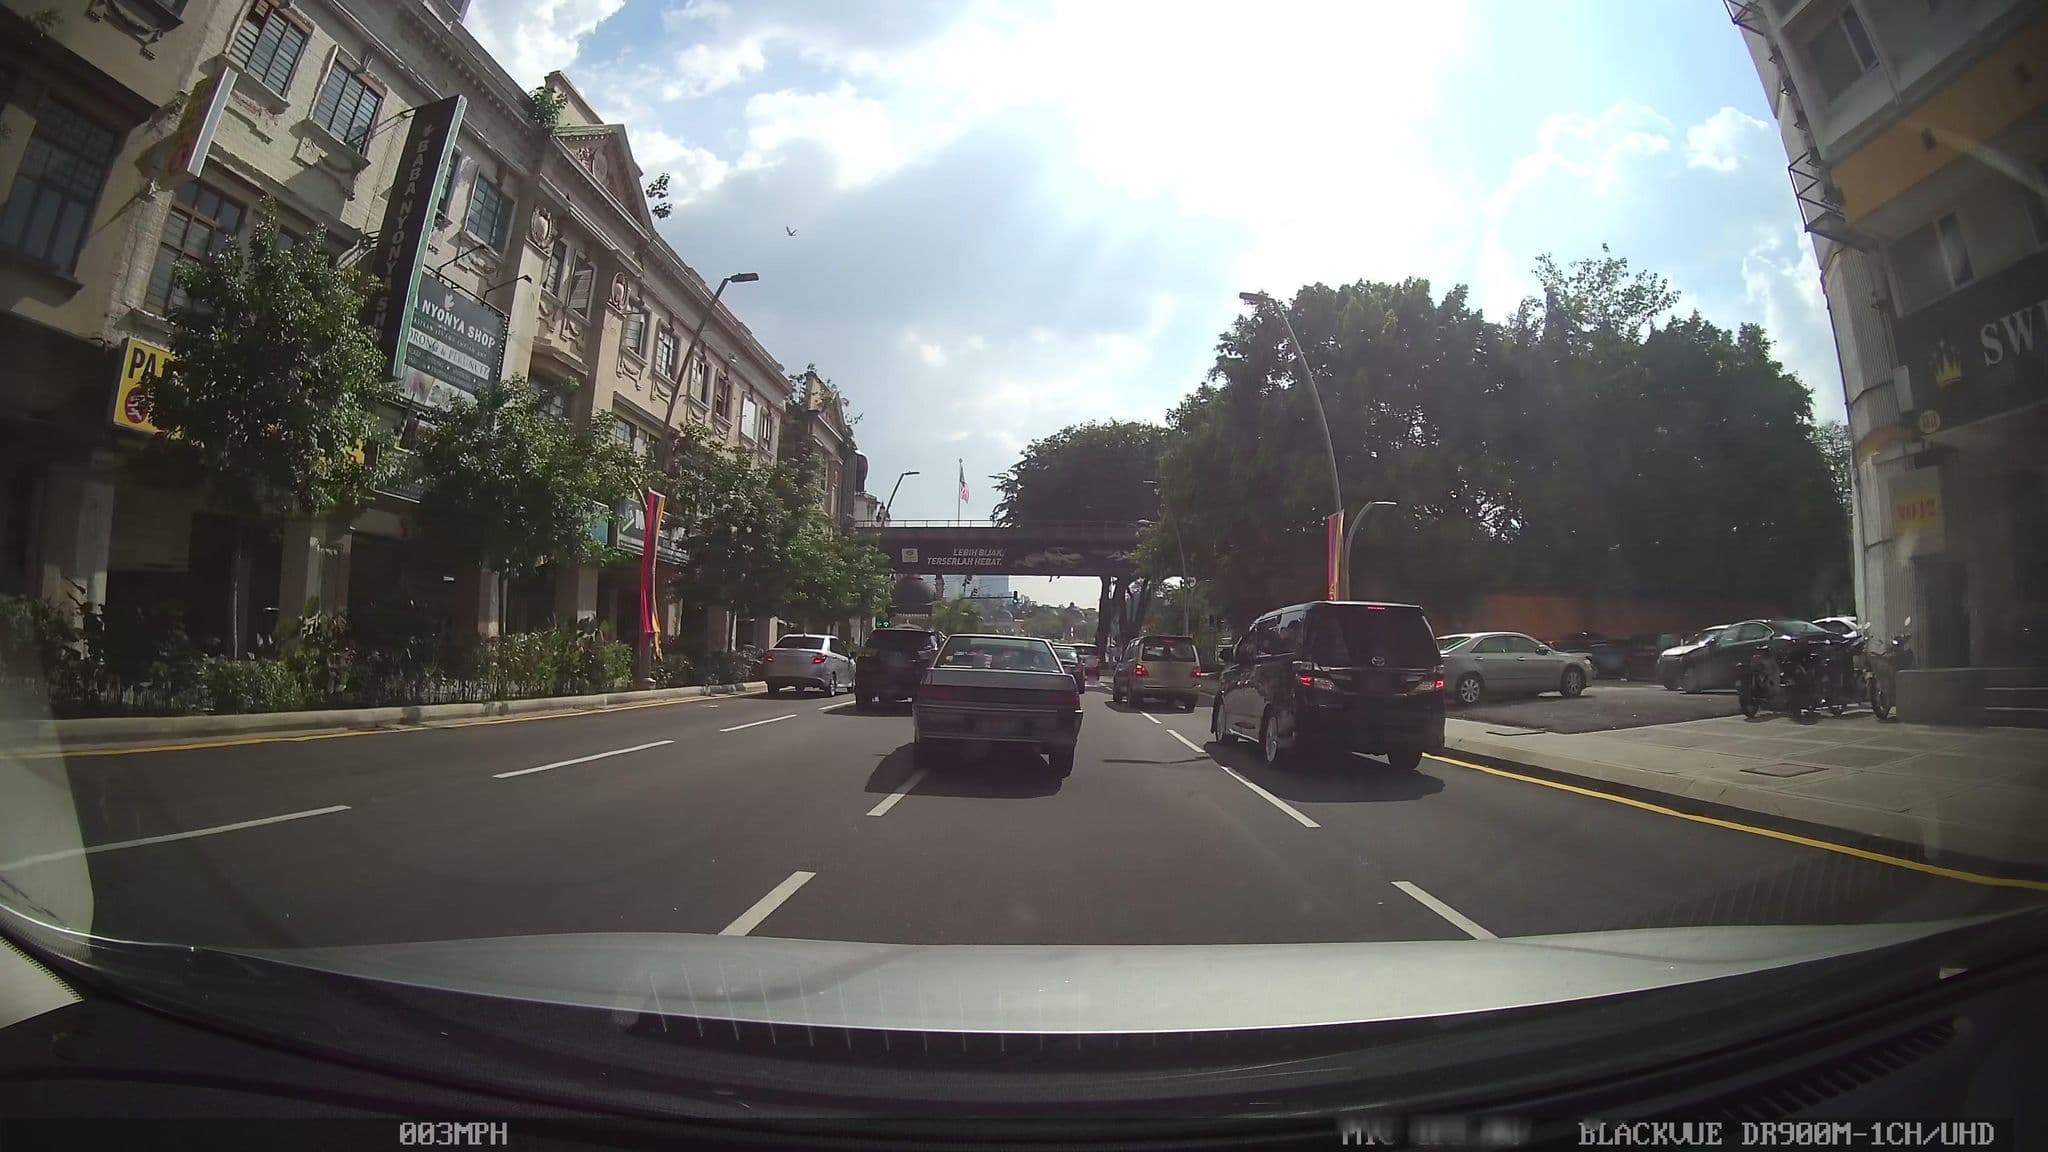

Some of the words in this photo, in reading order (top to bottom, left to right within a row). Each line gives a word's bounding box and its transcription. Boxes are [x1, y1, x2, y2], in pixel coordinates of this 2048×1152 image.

[404, 139, 429, 196] BABA
[382, 198, 412, 290] NYONYA
[422, 299, 465, 334] NYONYA
[467, 326, 496, 348] SHOP
[927, 557, 974, 565] TERSERLAH
[953, 548, 978, 556] LEBIH
